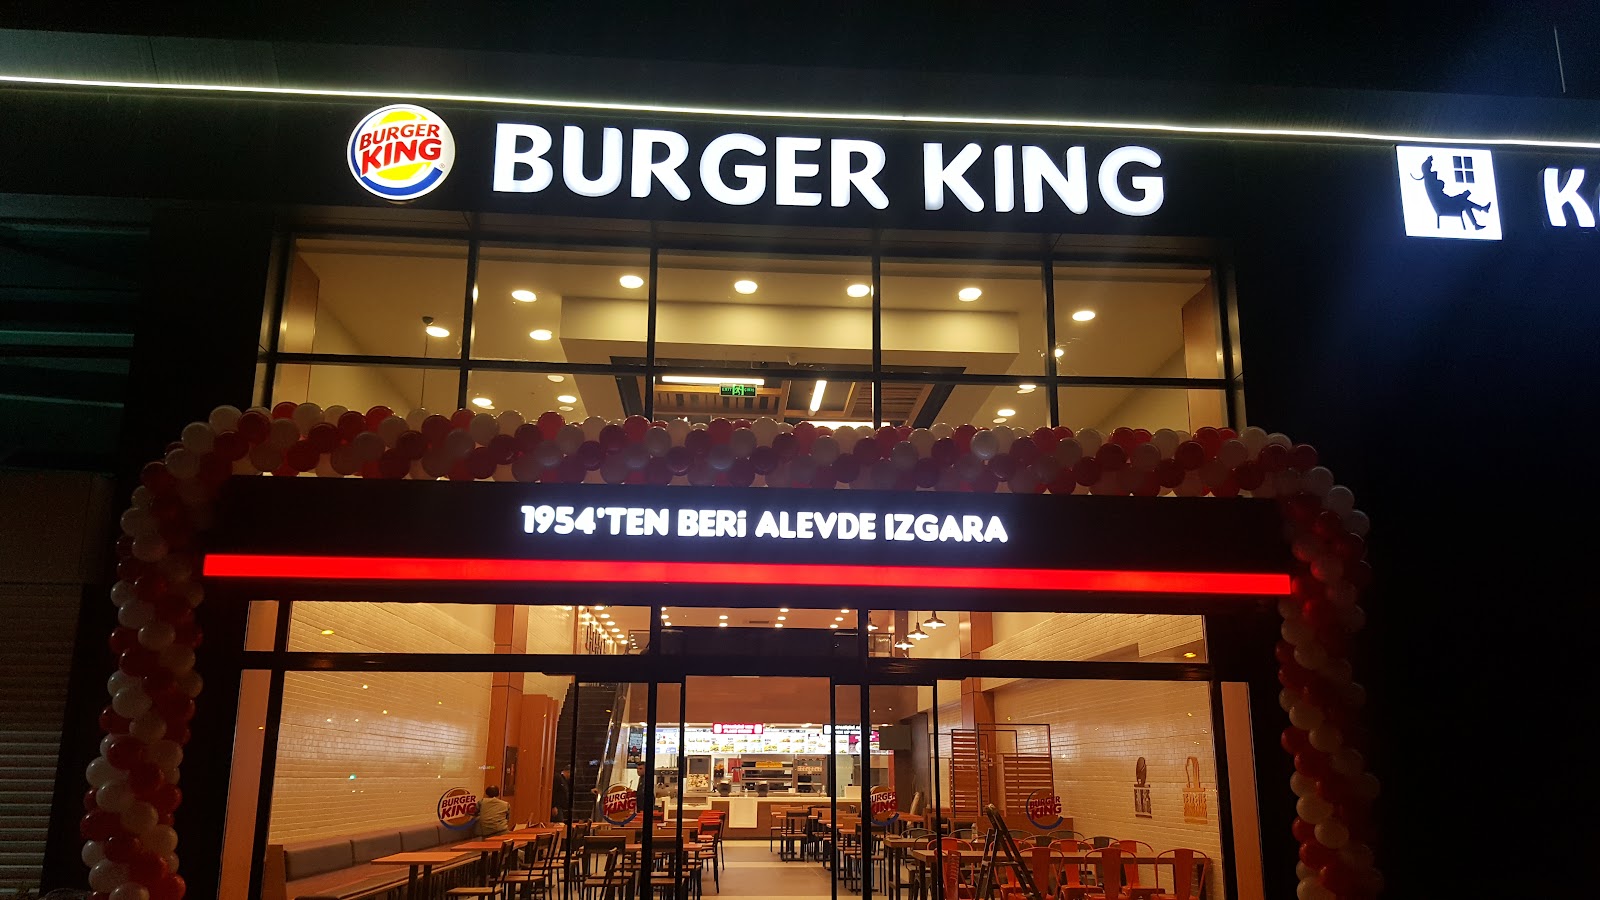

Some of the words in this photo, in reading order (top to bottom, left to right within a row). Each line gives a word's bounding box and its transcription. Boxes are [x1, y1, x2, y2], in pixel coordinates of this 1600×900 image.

[359, 123, 440, 151] BURGER
[362, 138, 442, 175] KING
[493, 122, 890, 210] BURGER
[923, 142, 1164, 217] KING
[1543, 167, 1600, 228] K
[521, 505, 670, 537] 1954'TEN
[754, 511, 877, 541] ALEVDE
[884, 514, 1009, 543] IZGARA
[442, 795, 477, 808] BURGER
[442, 802, 477, 819] KING
